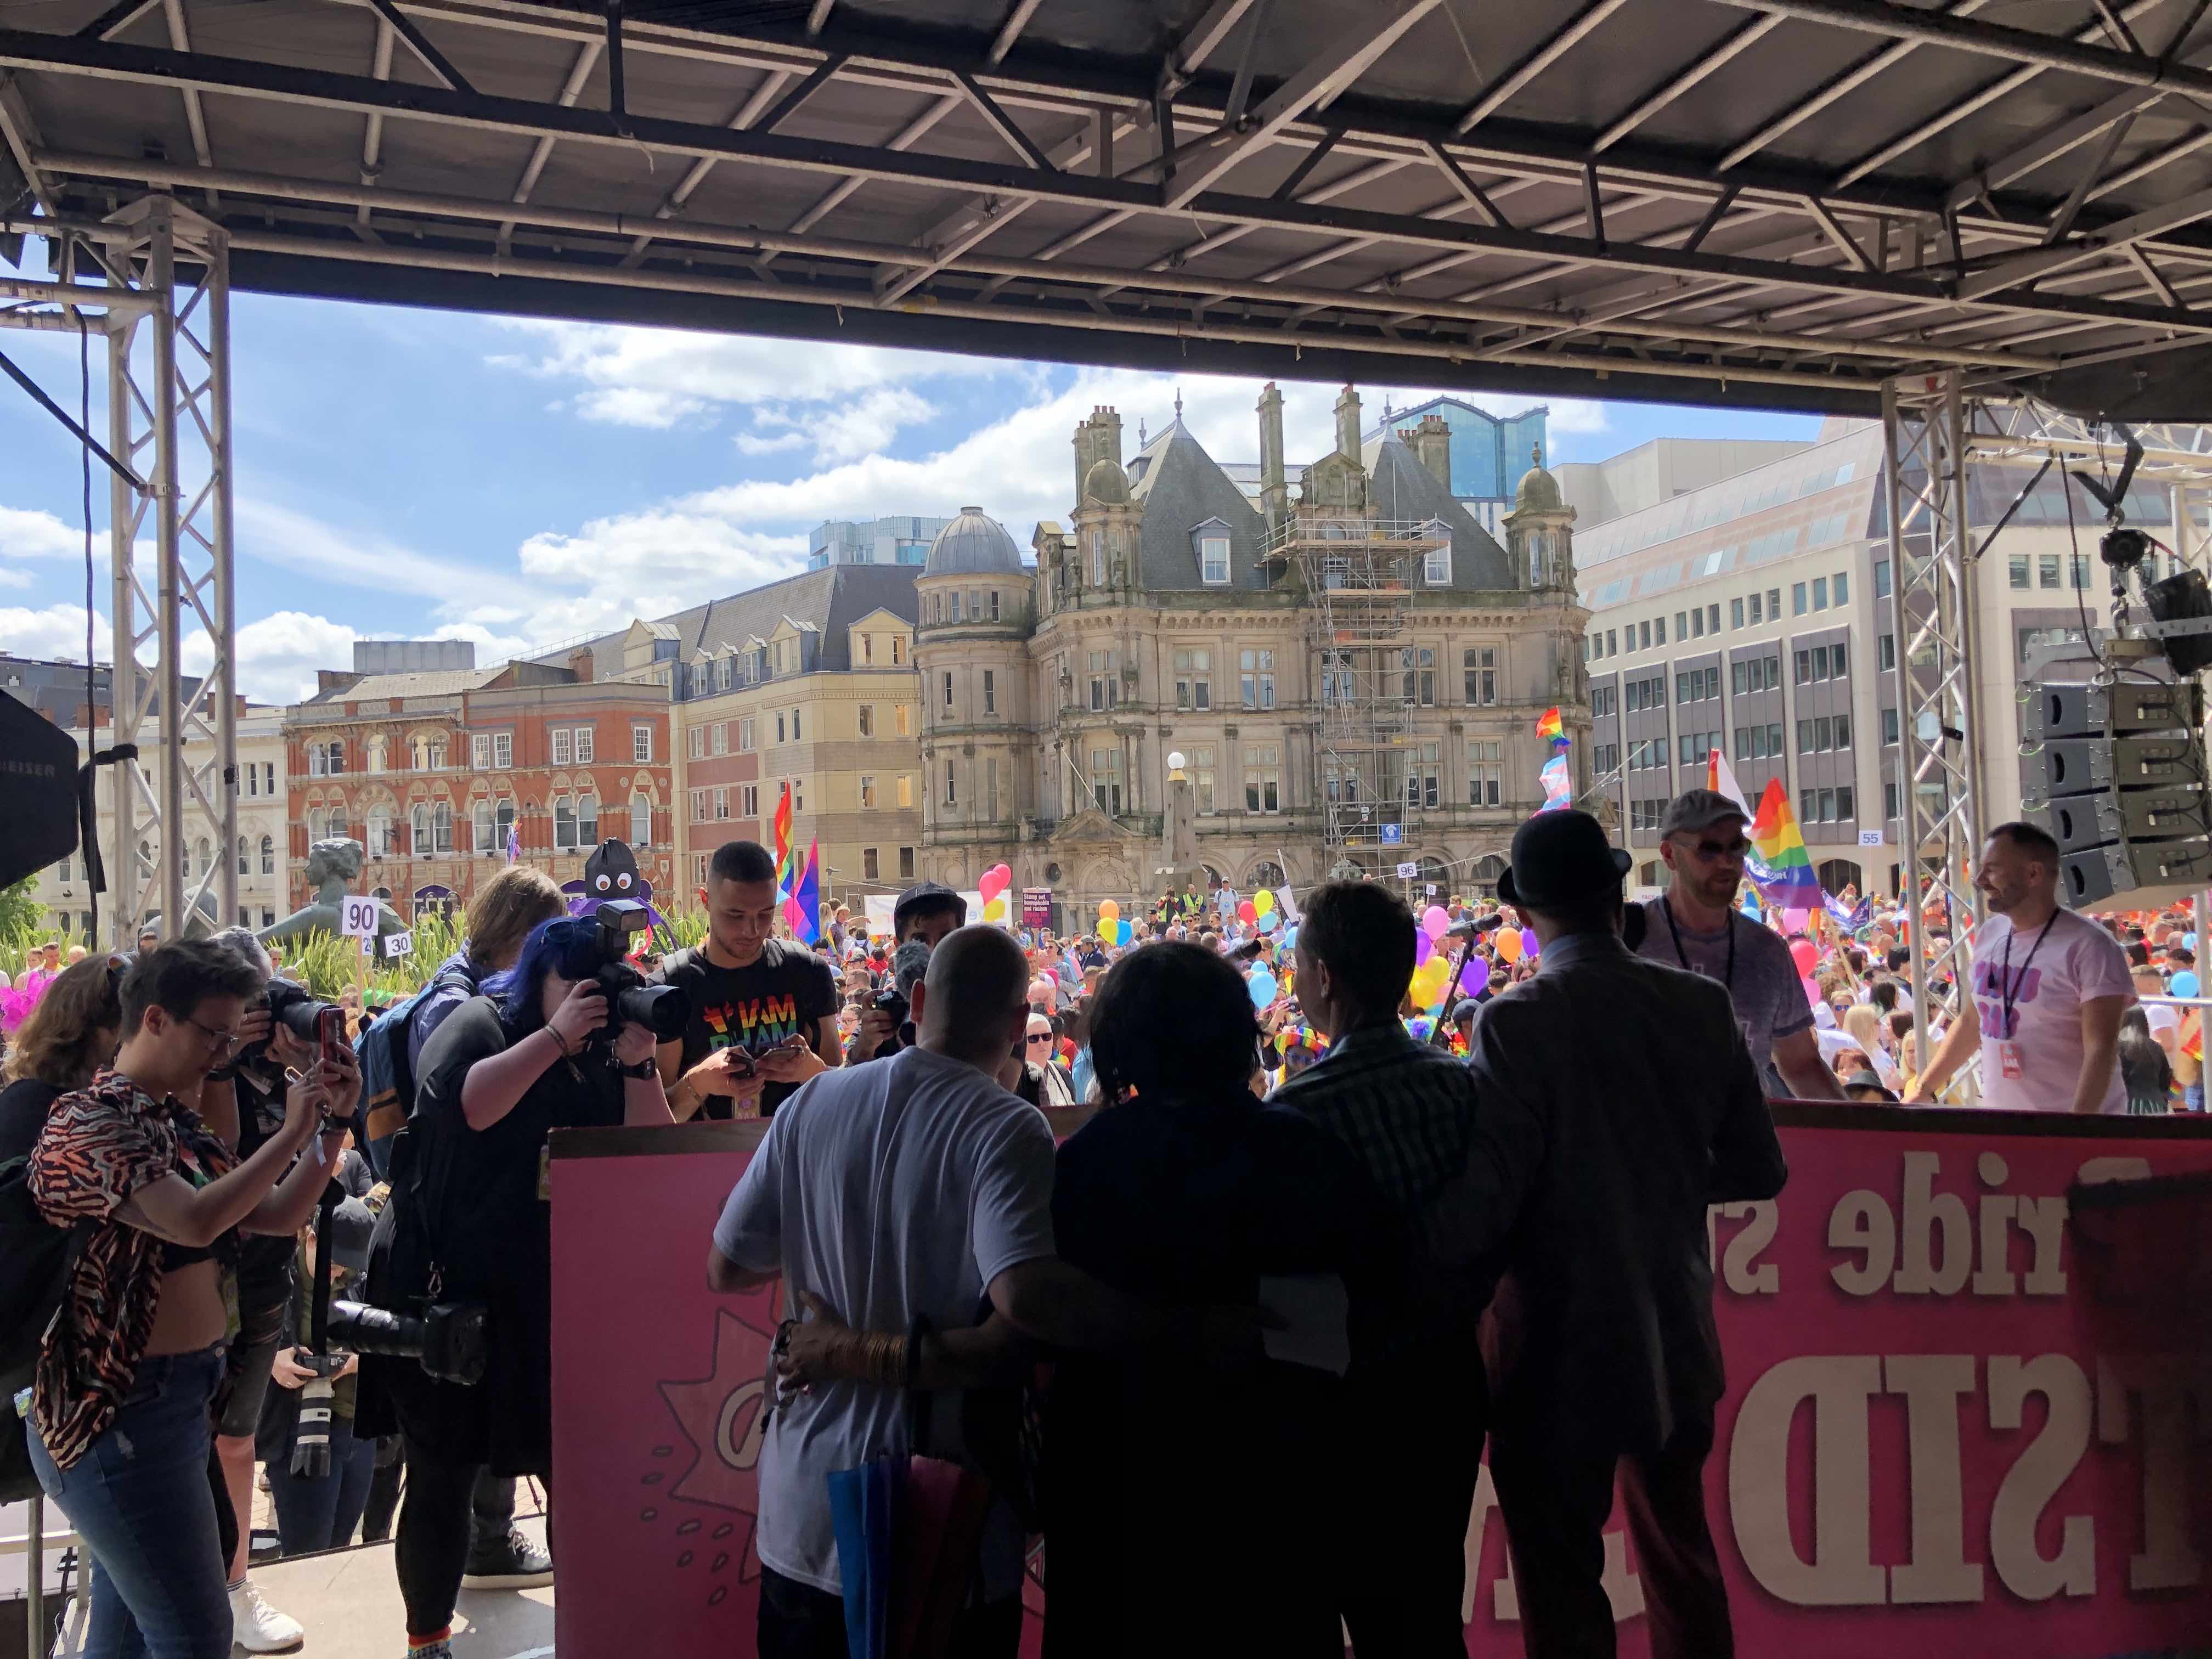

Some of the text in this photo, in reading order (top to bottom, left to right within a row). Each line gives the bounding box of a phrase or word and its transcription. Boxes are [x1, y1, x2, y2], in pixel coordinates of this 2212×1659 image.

[1863, 833, 1878, 844] 55
[1400, 866, 1414, 876] 96
[349, 904, 374, 930] 90
[391, 937, 408, 953] 30
